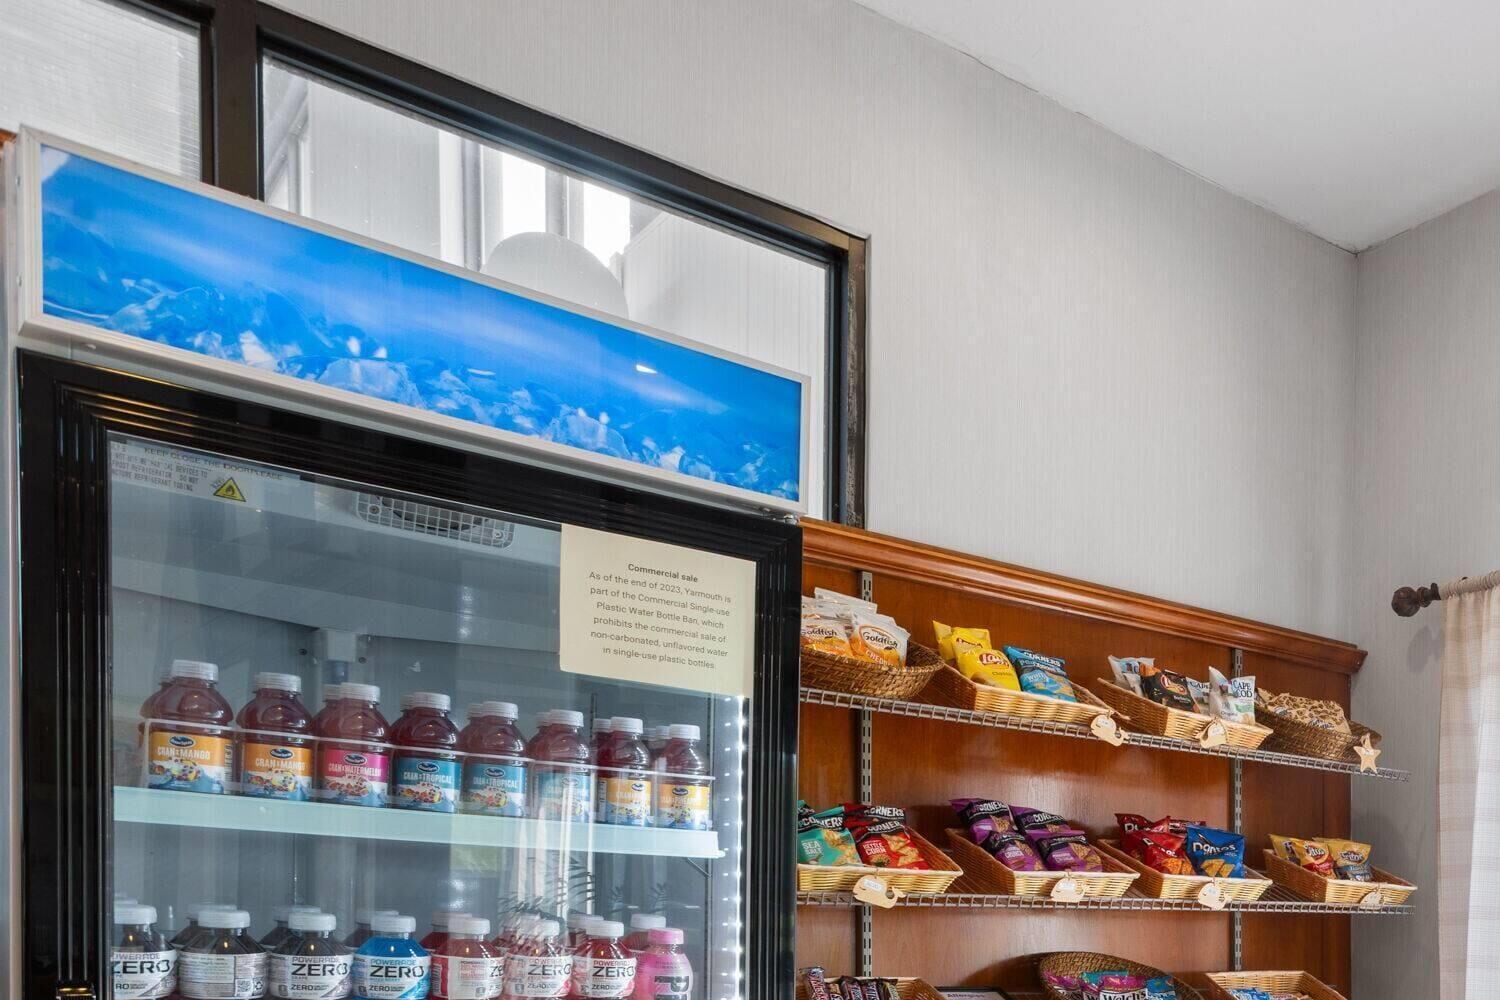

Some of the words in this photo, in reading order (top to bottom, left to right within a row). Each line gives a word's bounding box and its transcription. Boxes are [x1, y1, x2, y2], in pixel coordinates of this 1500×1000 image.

[628, 563, 679, 580] Commercial
[681, 573, 698, 582] sale
[589, 571, 600, 580] As
[603, 574, 613, 582] of
[614, 576, 629, 585] the
[630, 579, 647, 588] end
[649, 582, 659, 590] of
[684, 588, 723, 602] Yarmouth
[724, 596, 732, 604] is
[590, 587, 608, 597] part
[610, 589, 620, 598] of
[622, 592, 636, 601] the
[638, 594, 688, 609] Commercial
[690, 602, 730, 616] Single-use
[596, 602, 627, 614] Plastic
[628, 606, 654, 617] Water
[656, 610, 680, 622] Bottle
[701, 618, 724, 629] which
[593, 617, 632, 628] prohibits
[634, 622, 648, 630] the
[650, 625, 698, 639] commercial
[700, 633, 716, 642] sale
[862, 631, 898, 648] Goldfish
[603, 646, 611, 654] in
[613, 648, 657, 660] single-use
[660, 654, 686, 665] plastic
[663, 640, 704, 654] unflavored
[706, 648, 728, 657] water
[1233, 680, 1251, 691] CAPE
[422, 772, 453, 784] TROPICAL
[291, 963, 348, 976] ZERO
[370, 958, 416, 966] POWERADE
[370, 966, 424, 978] ZERO
[527, 964, 572, 976] ZERO
[592, 966, 636, 978] ZERO
[369, 984, 390, 992] ZERO
